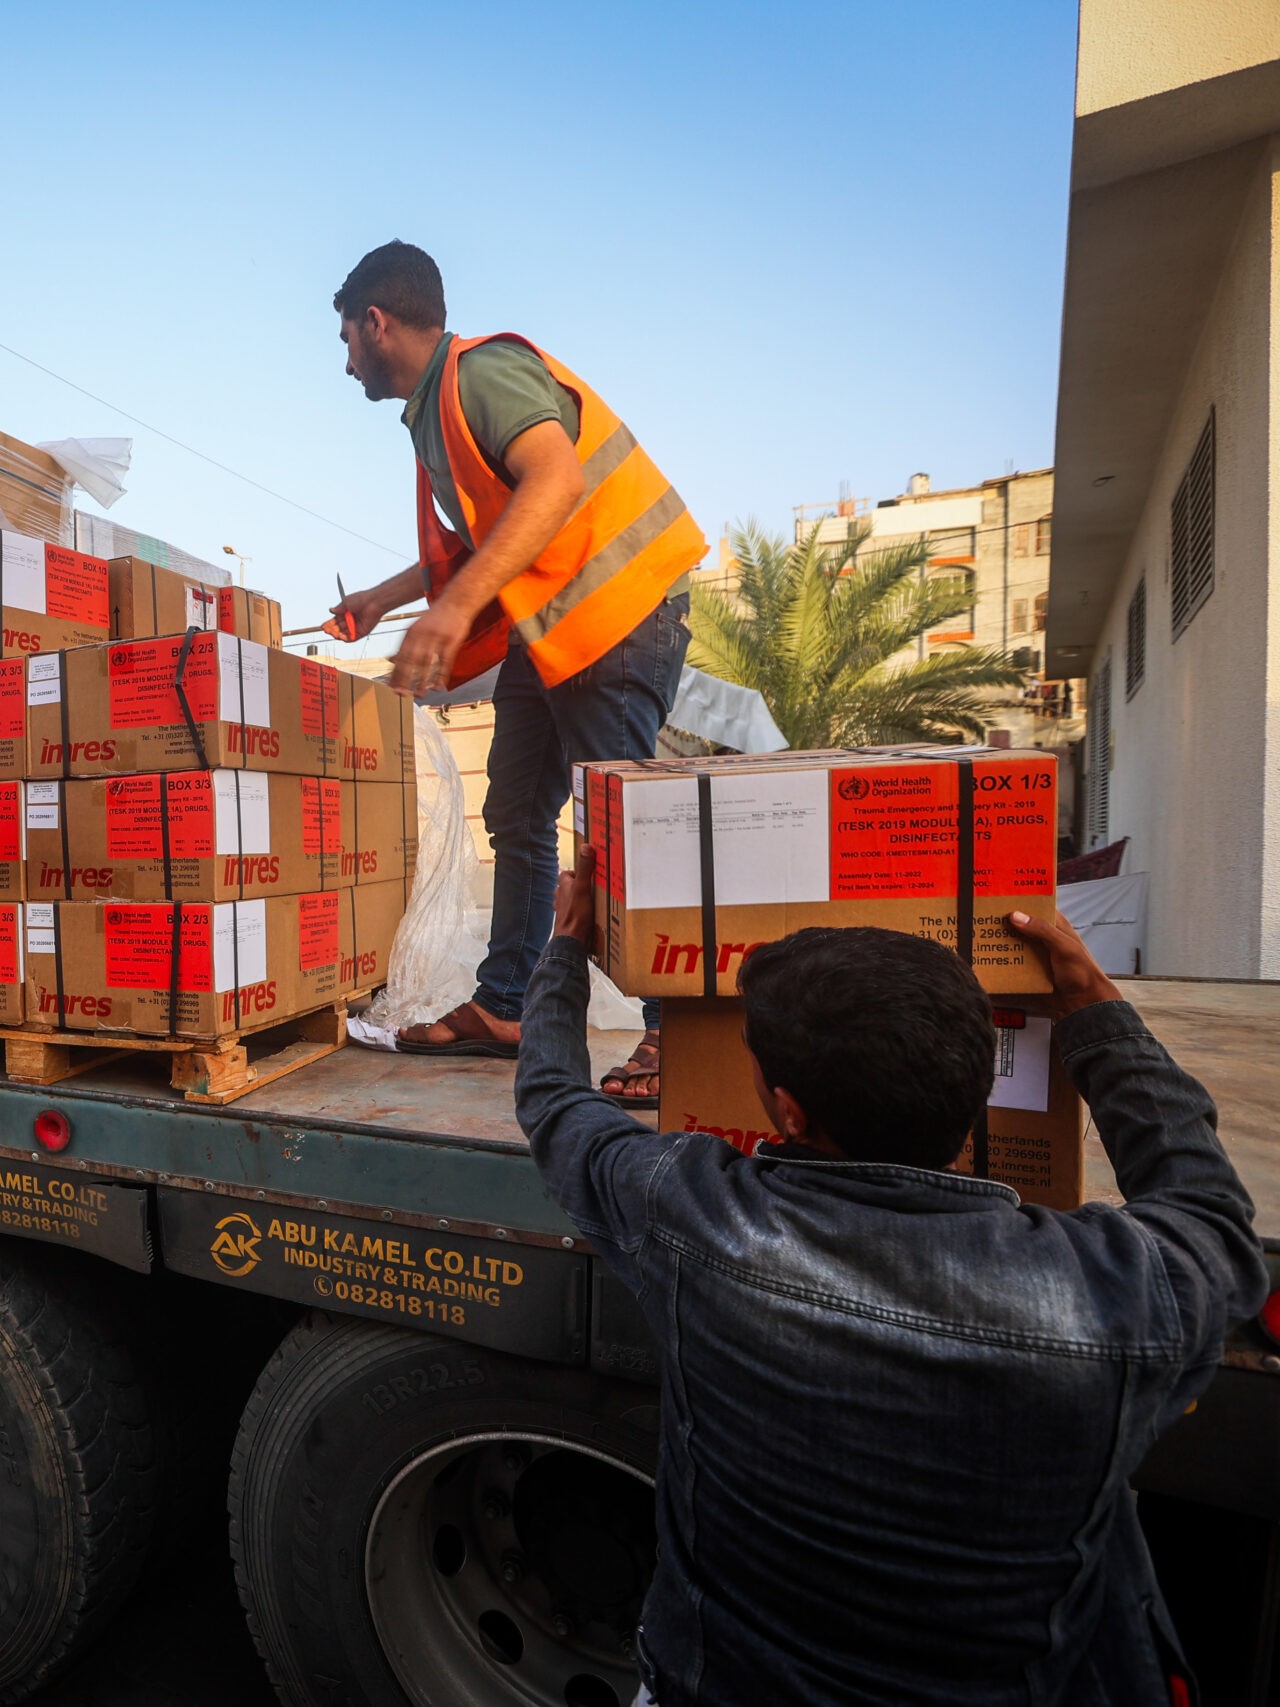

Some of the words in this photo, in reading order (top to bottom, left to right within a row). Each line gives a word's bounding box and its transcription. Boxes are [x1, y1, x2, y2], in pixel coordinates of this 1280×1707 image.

[83, 561, 97, 572] BOX
[171, 646, 195, 658] BX
[198, 643, 214, 654] 2/3
[9, 666, 22, 676] 3/3
[147, 674, 173, 682] MODULE
[137, 681, 188, 692] DISINFECTATS
[227, 722, 280, 758] imres
[40, 737, 116, 765] imres
[343, 737, 377, 771] imres
[168, 781, 191, 791] BOX
[195, 779, 211, 789] 3/3
[872, 779, 898, 788] World
[902, 777, 931, 787] Health
[1021, 773, 1052, 790] 1/3
[4, 790, 17, 800] 2/3
[872, 786, 931, 798] Organization
[143, 805, 169, 813] MODUE
[853, 806, 885, 815] Trauma
[887, 804, 935, 815] Emergency
[938, 804, 954, 812] and
[993, 801, 1006, 809] Kit
[1014, 801, 1036, 809] 2019
[133, 815, 183, 823] DISINFECANTS
[837, 821, 875, 833] (TESK
[879, 819, 906, 830] 2019
[975, 817, 993, 828] A),
[996, 814, 1048, 826] DRUGS,
[889, 831, 992, 844] DISINFECTTS
[341, 845, 377, 877] imres
[840, 850, 857, 858] WHO
[39, 861, 113, 888] imres
[223, 854, 279, 886] imres
[837, 871, 872, 880] Assembly
[1, 912, 14, 922] 3/3
[193, 914, 209, 924] 2/3
[919, 916, 942, 927] The
[142, 938, 169, 946] MODULE
[937, 929, 976, 941] (0)30
[340, 950, 377, 984] imres
[38, 986, 113, 1017] imres
[222, 981, 277, 1022] imres
[1004, 1147, 1051, 1161] 296969
[48, 1180, 108, 1212] CO.LTD
[210, 1231, 263, 1262] AK
[267, 1219, 316, 1246] ABU
[324, 1228, 416, 1267] KAMEL
[424, 1247, 524, 1286] CO.LTD
[335, 1281, 465, 1325] 082818118
[361, 1359, 485, 1417] 13R22.5
